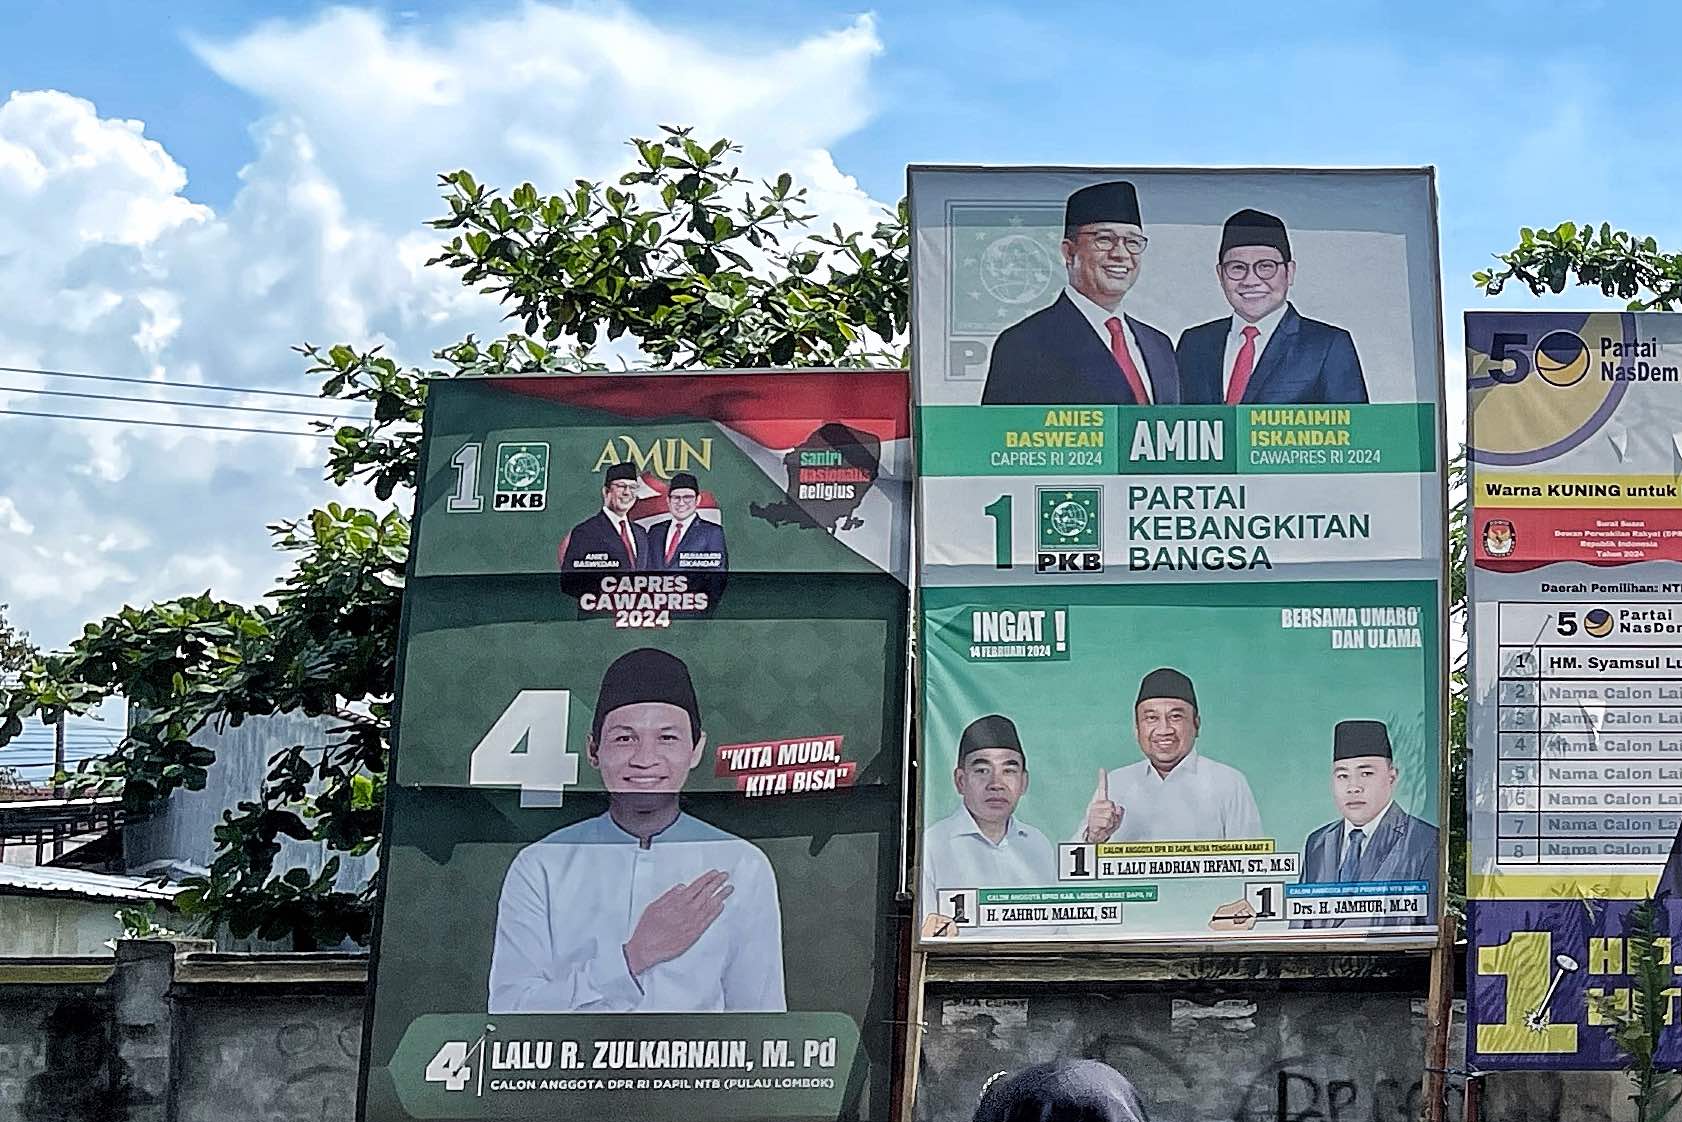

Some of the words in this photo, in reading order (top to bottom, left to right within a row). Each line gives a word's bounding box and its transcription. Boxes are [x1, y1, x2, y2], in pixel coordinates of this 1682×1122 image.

[1488, 333, 1530, 384] 5
[1600, 337, 1657, 359] Partai
[1600, 361, 1679, 382] NasDem
[1044, 410, 1105, 427] ANIES
[1250, 410, 1351, 426] MUHAIMIN
[1006, 430, 1105, 448] BASWEAN
[1129, 420, 1224, 462] AMIN
[1250, 430, 1351, 446] ISKANDAR
[592, 435, 713, 480] AMIN
[991, 452, 1048, 466] CAPRES
[1052, 452, 1064, 465] RI
[1068, 451, 1103, 466] 2024
[1250, 451, 1325, 465] CAWAPRES
[1329, 451, 1342, 464] RI
[1347, 449, 1382, 464] 2024
[447, 441, 484, 514] 1
[799, 483, 855, 501] Religius
[1129, 486, 1246, 511] PARTAI
[1486, 484, 1542, 497] Warna
[1547, 484, 1621, 497] KUNING
[1627, 483, 1677, 497] untuk
[494, 493, 545, 511] PKB
[984, 494, 1013, 570] 1
[1129, 513, 1370, 541] KEBANGKITAN
[1037, 552, 1102, 572] PKB
[1129, 545, 1274, 572] BANGSA
[601, 576, 688, 593] CAPRES
[580, 593, 708, 611] CAWAPRES
[615, 610, 670, 628] 2024
[972, 611, 1047, 642] INGAT
[1282, 608, 1357, 628] BERSAMA
[1332, 629, 1365, 649] DAN
[1368, 628, 1421, 648] ULAMA
[1515, 656, 1526, 668] 1
[1550, 657, 1582, 669] HM.
[1588, 656, 1660, 672] Syamsul
[470, 689, 579, 808] 4
[1476, 931, 1578, 1053] 1
[491, 1041, 553, 1070] LALU
[560, 1041, 584, 1069] R.
[594, 1039, 754, 1071] ZULKARNAIN,
[762, 1040, 795, 1068] M.
[804, 1037, 837, 1068] Pd
[425, 1042, 470, 1091] 4
